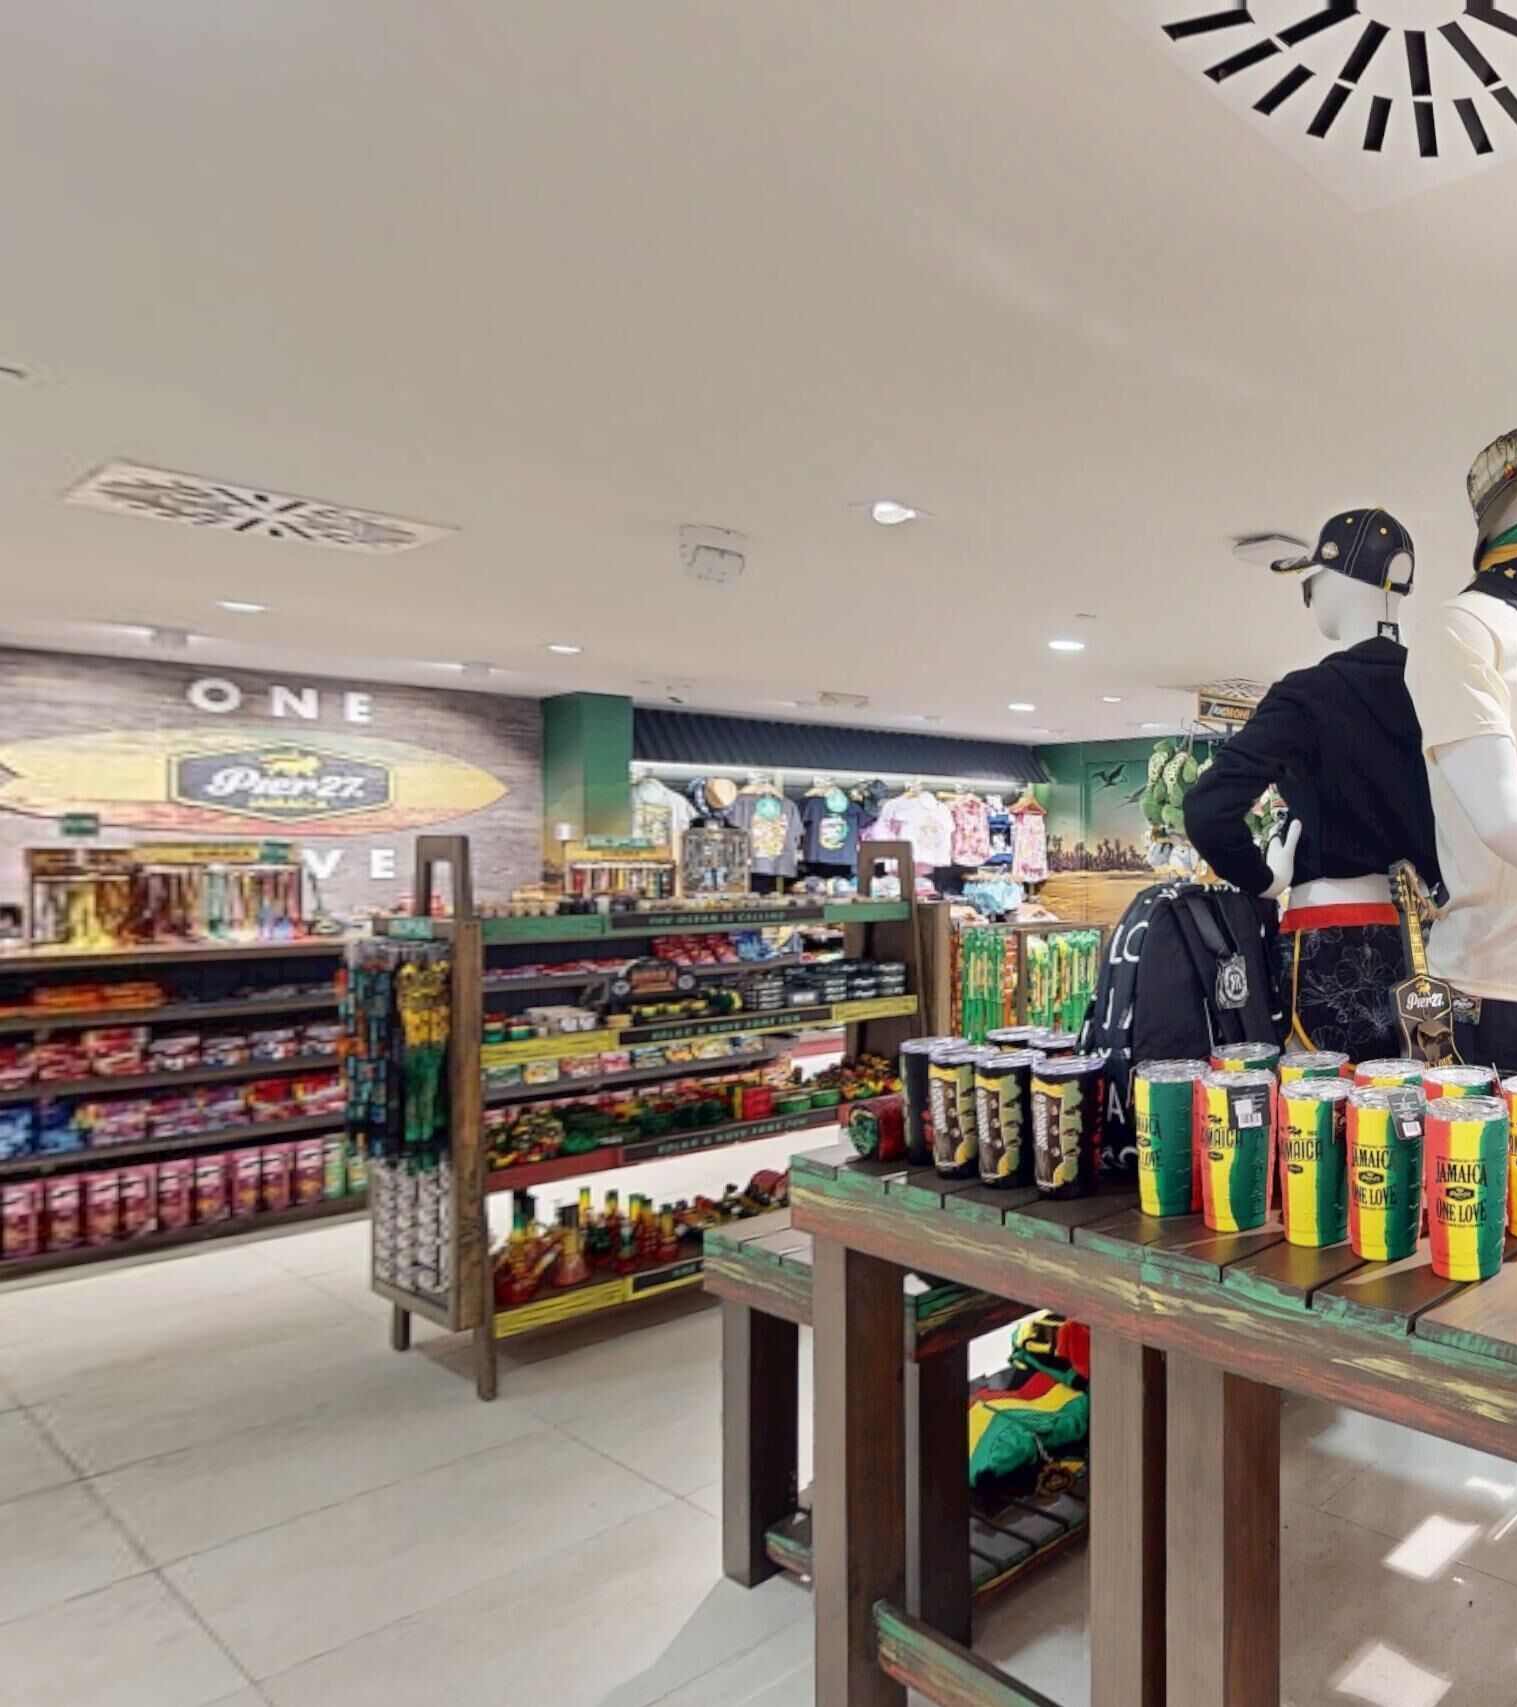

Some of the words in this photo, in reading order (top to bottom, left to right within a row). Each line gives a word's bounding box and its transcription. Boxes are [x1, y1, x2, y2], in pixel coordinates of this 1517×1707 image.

[186, 677, 373, 723] ONE
[1436, 1160, 1488, 1188] JAMAICA
[1436, 1196, 1456, 1222] ONE
[1459, 1199, 1488, 1223] LOVE
